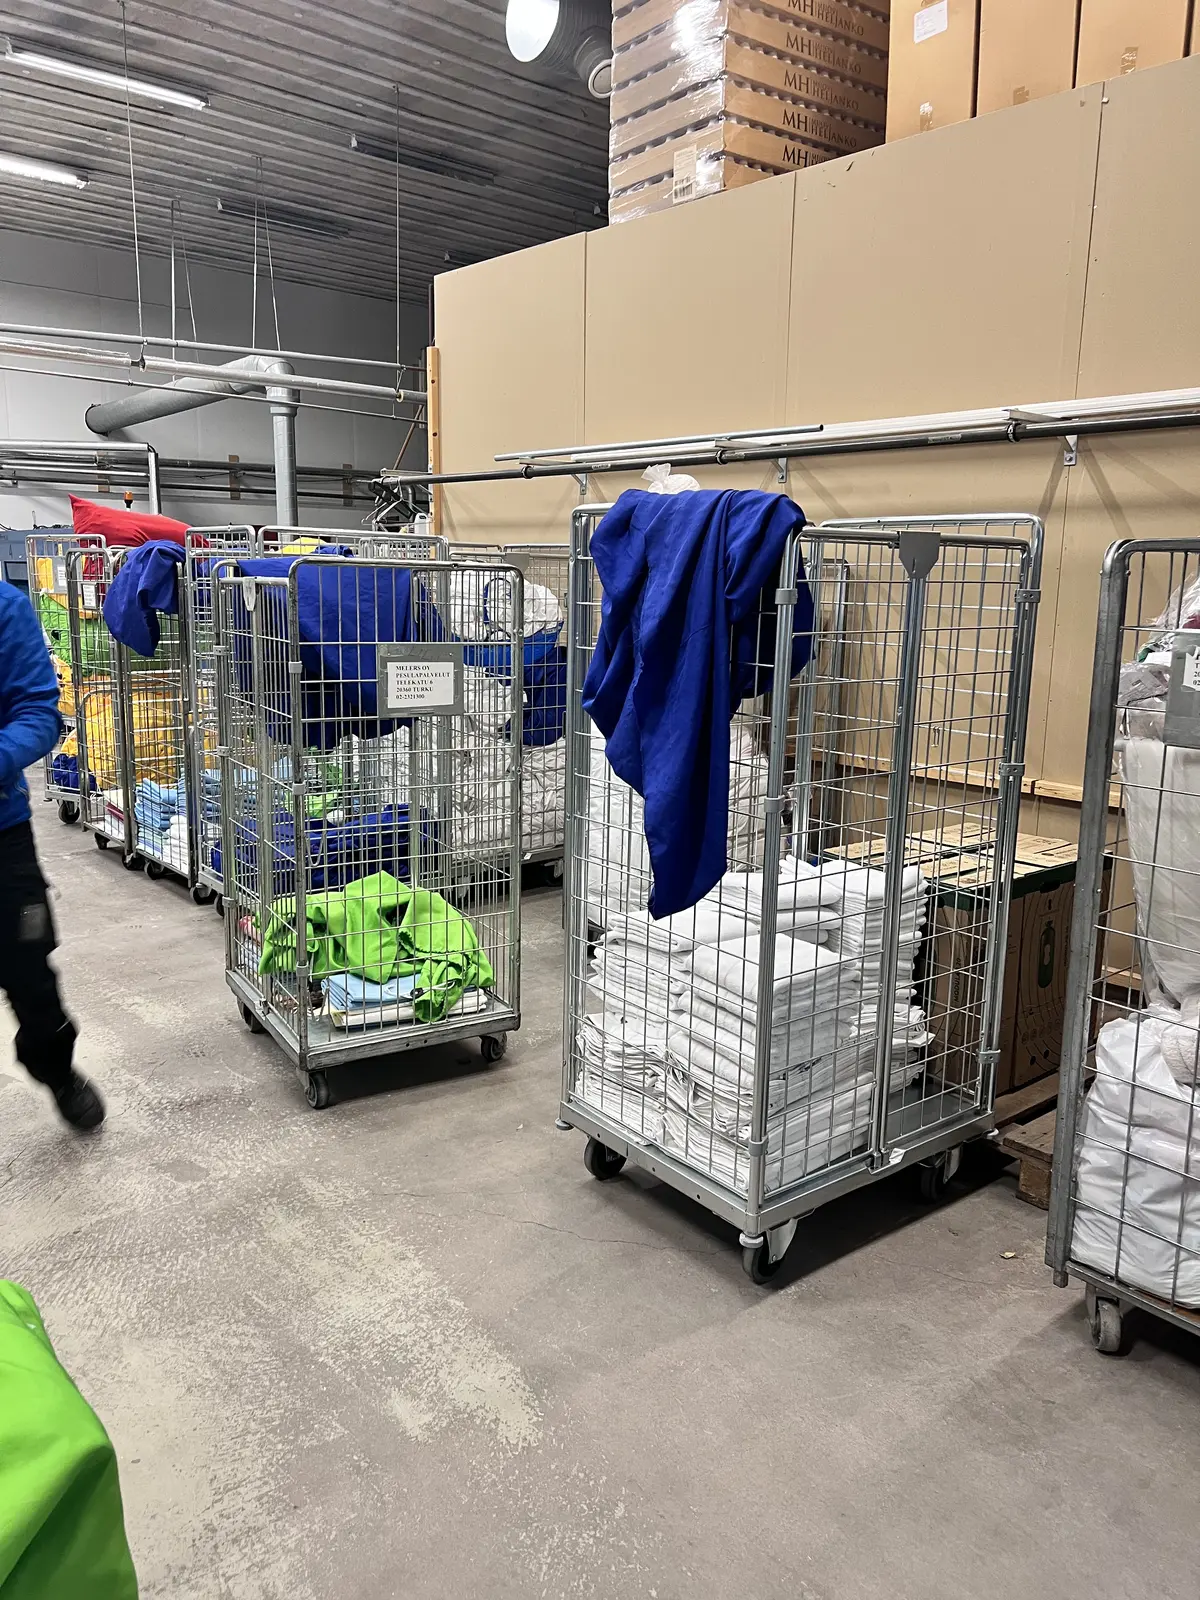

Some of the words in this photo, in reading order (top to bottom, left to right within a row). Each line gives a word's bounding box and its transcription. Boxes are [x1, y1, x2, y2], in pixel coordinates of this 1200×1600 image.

[817, 8, 864, 36] HELJANKO
[786, 31, 812, 56] MH
[784, 70, 809, 94] MH
[812, 86, 858, 111] HELJANKO
[782, 108, 808, 133] MH
[811, 123, 857, 148] HELJANKO
[782, 144, 808, 167] MH
